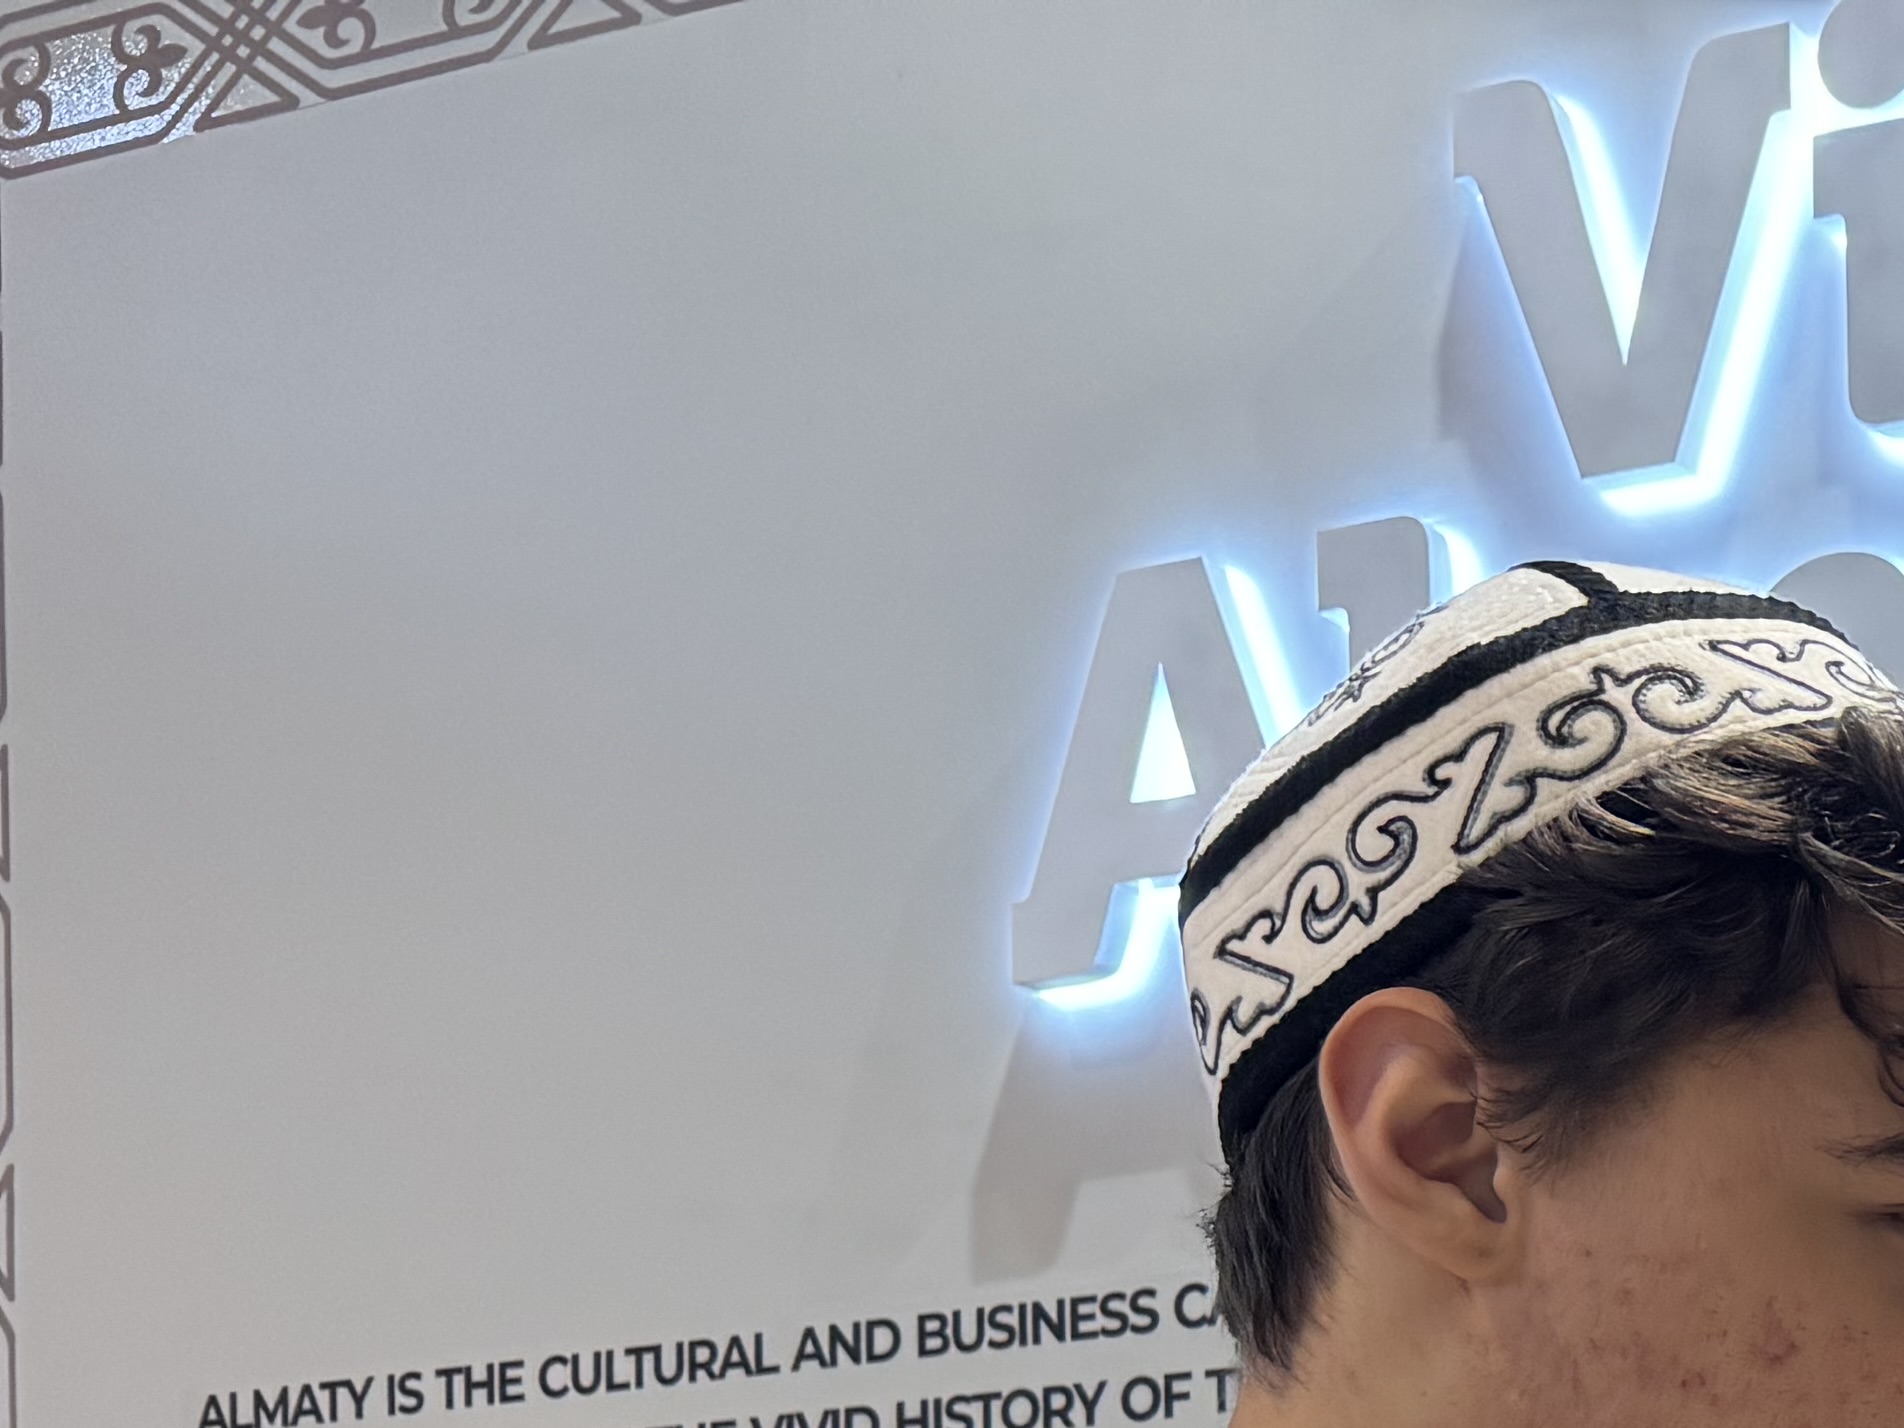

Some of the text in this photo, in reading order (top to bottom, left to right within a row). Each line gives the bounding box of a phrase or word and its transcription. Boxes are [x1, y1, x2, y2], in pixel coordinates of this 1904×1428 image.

[387, 1371, 424, 1416] IS
[435, 1360, 525, 1410] THE
[538, 1333, 780, 1398] CULTURAL
[791, 1319, 901, 1372] AND
[917, 1288, 1160, 1358] BUSINESS
[1121, 1371, 1192, 1422] OF
